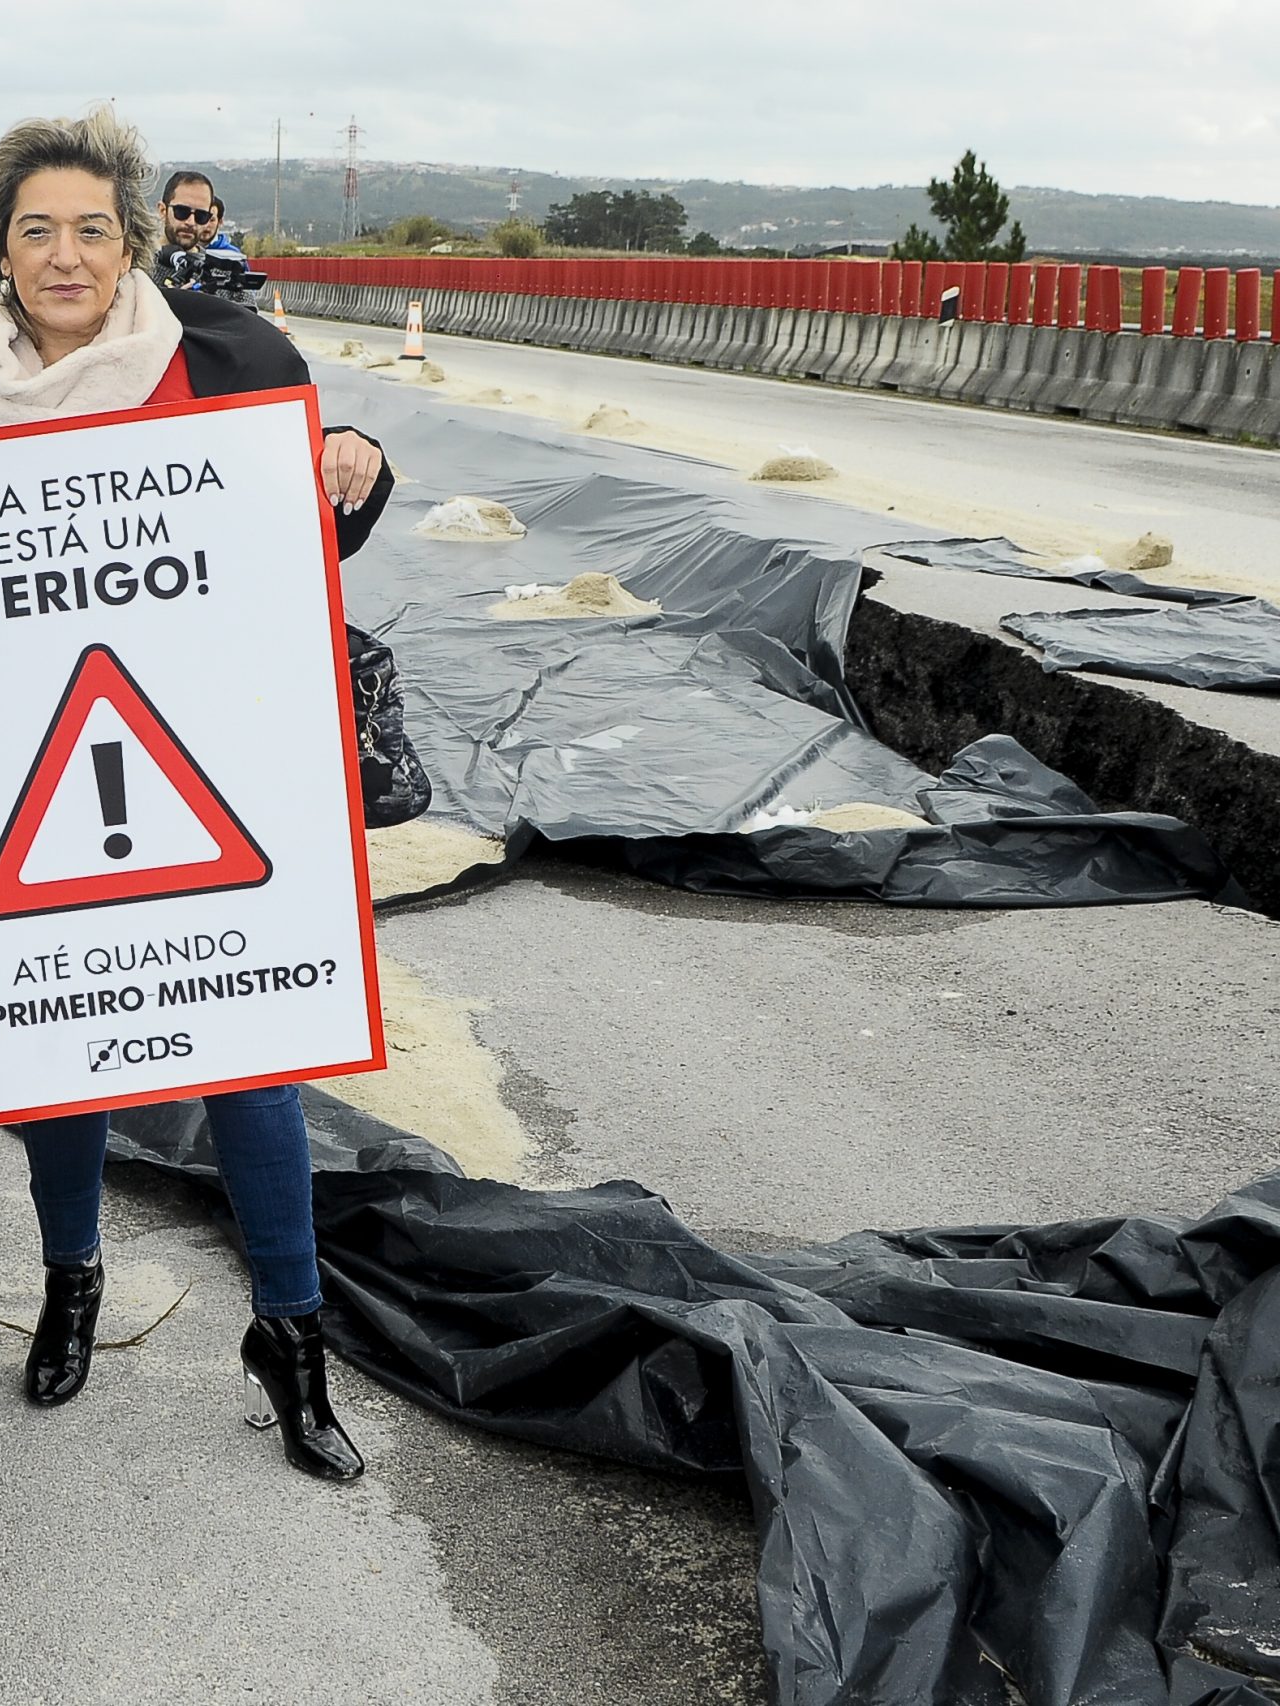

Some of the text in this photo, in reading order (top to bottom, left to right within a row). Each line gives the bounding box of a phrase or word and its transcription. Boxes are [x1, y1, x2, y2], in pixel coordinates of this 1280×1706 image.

[40, 458, 225, 512] ESTRADA
[102, 512, 171, 550] UM
[13, 929, 247, 986] ATÉ QUANDO
[122, 1032, 194, 1064] CDS
